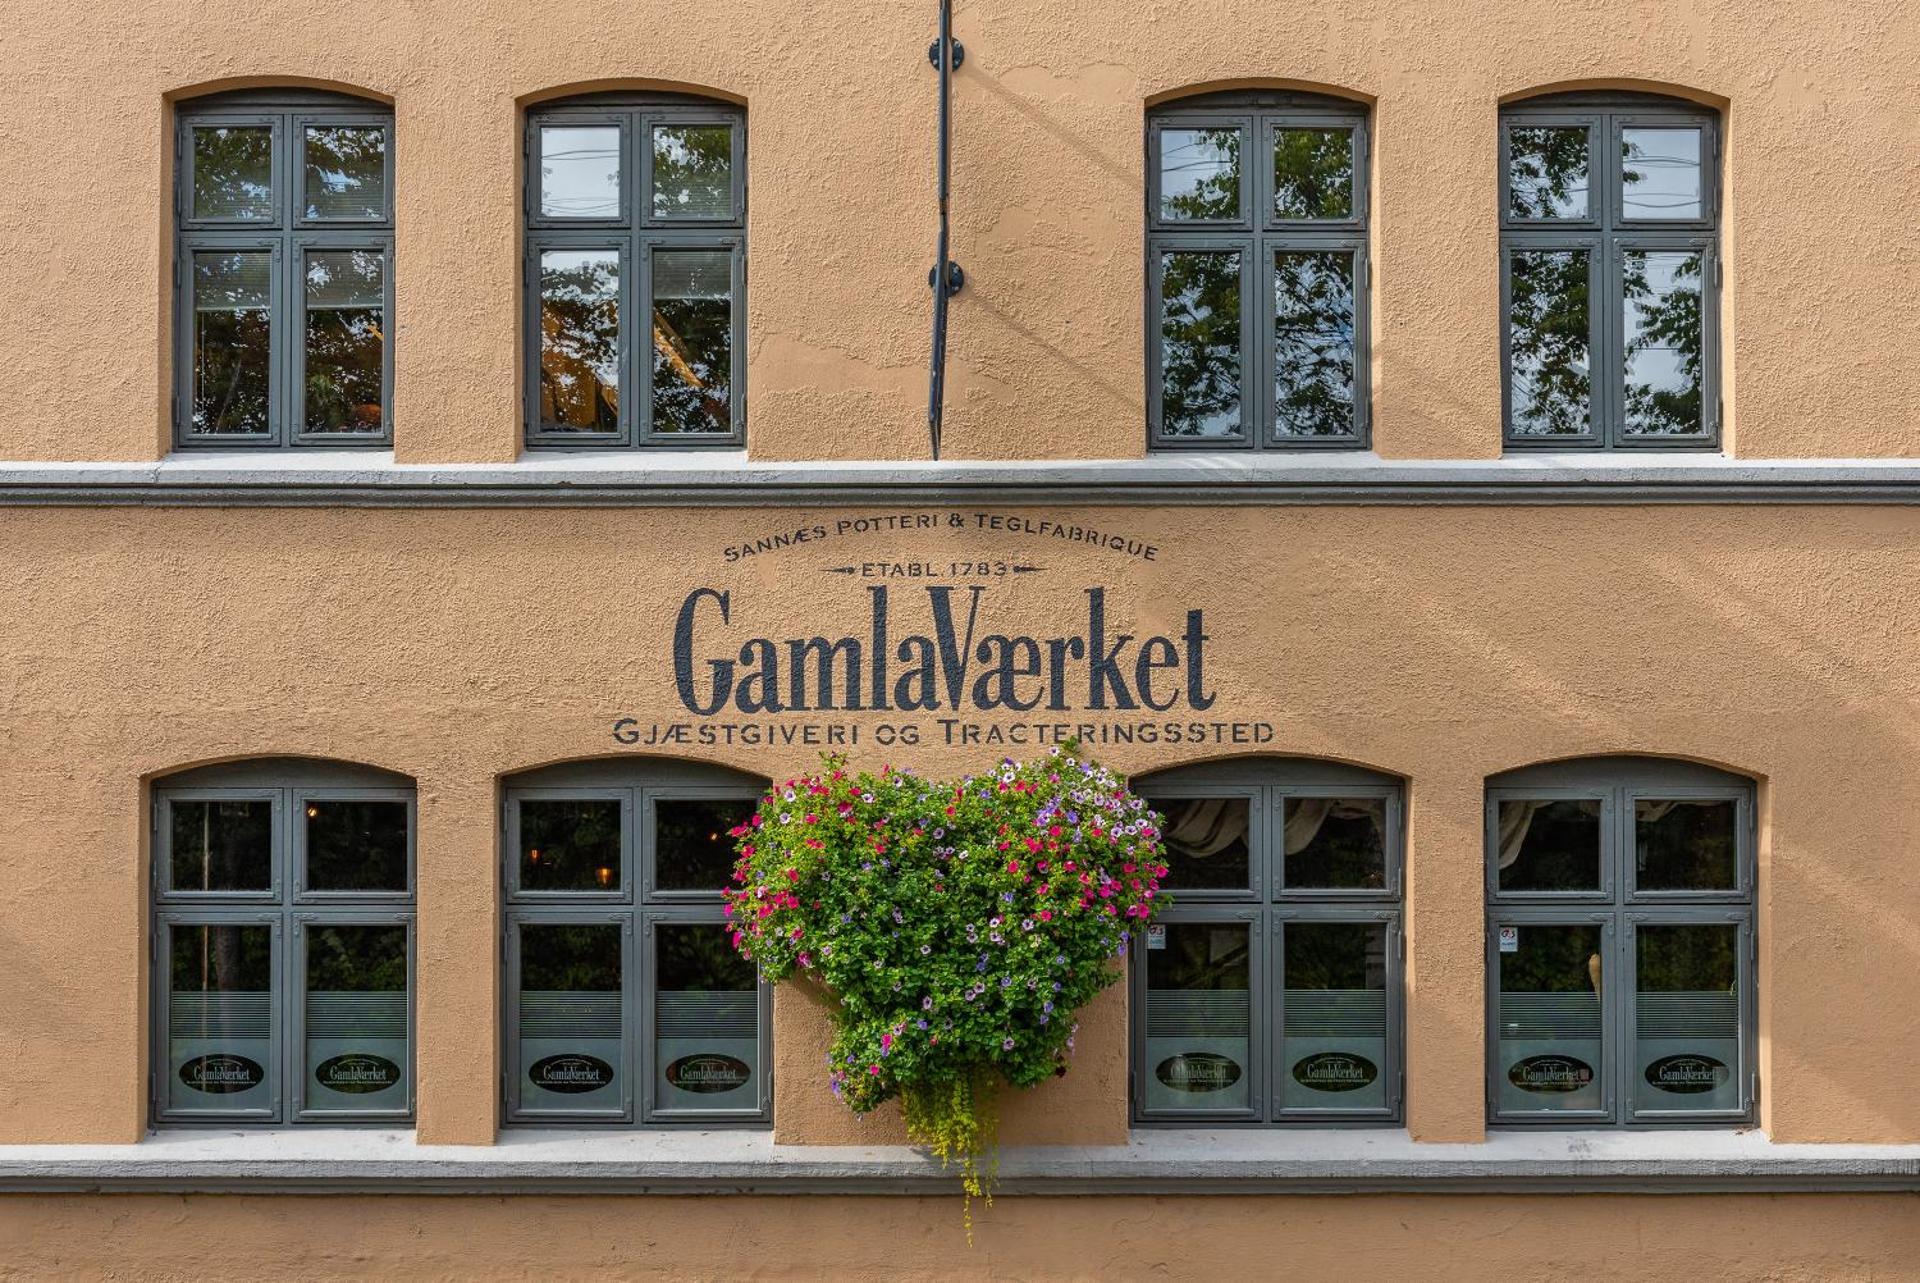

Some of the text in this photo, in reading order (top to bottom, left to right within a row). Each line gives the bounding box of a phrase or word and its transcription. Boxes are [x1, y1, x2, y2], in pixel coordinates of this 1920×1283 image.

[724, 513, 1159, 562] SANNÆS POTTERI & TEGLFABRIQUE
[951, 562, 1007, 576] 1783
[673, 585, 1217, 716] GamlaVærket
[613, 718, 1274, 745] GJÆSTGIVERI OG TRACTERINGSSTED
